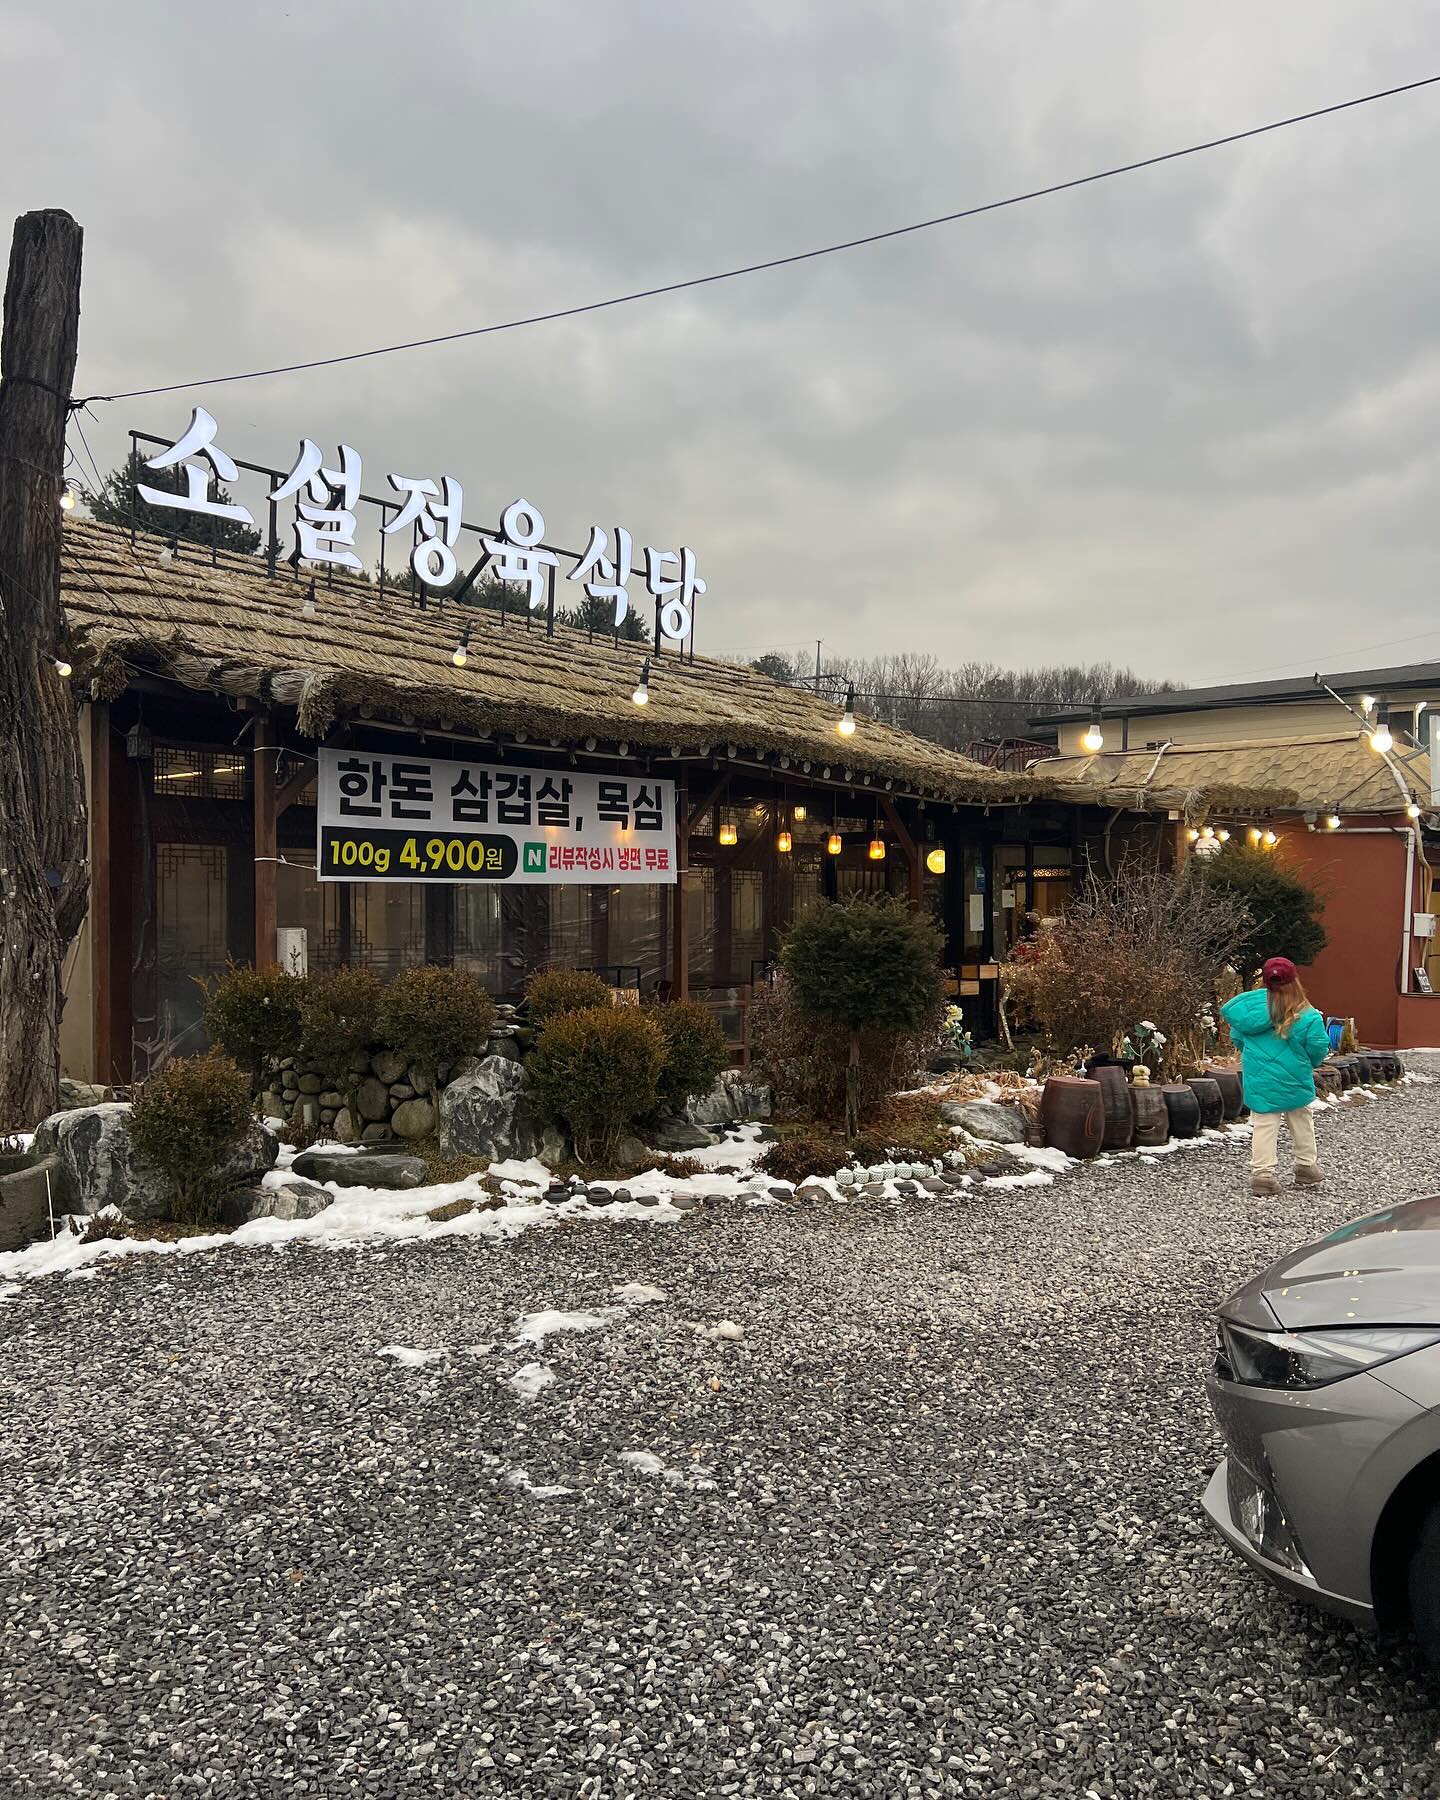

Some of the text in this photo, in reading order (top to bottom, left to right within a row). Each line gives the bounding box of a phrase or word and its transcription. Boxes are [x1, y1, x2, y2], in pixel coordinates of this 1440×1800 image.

[337, 758, 663, 832] 한돈 삼겹살, 목심
[330, 840, 390, 873] 100g
[549, 846, 614, 870] 리뷰작성시
[617, 848, 641, 871] 냉면
[645, 848, 669, 871] 무료
